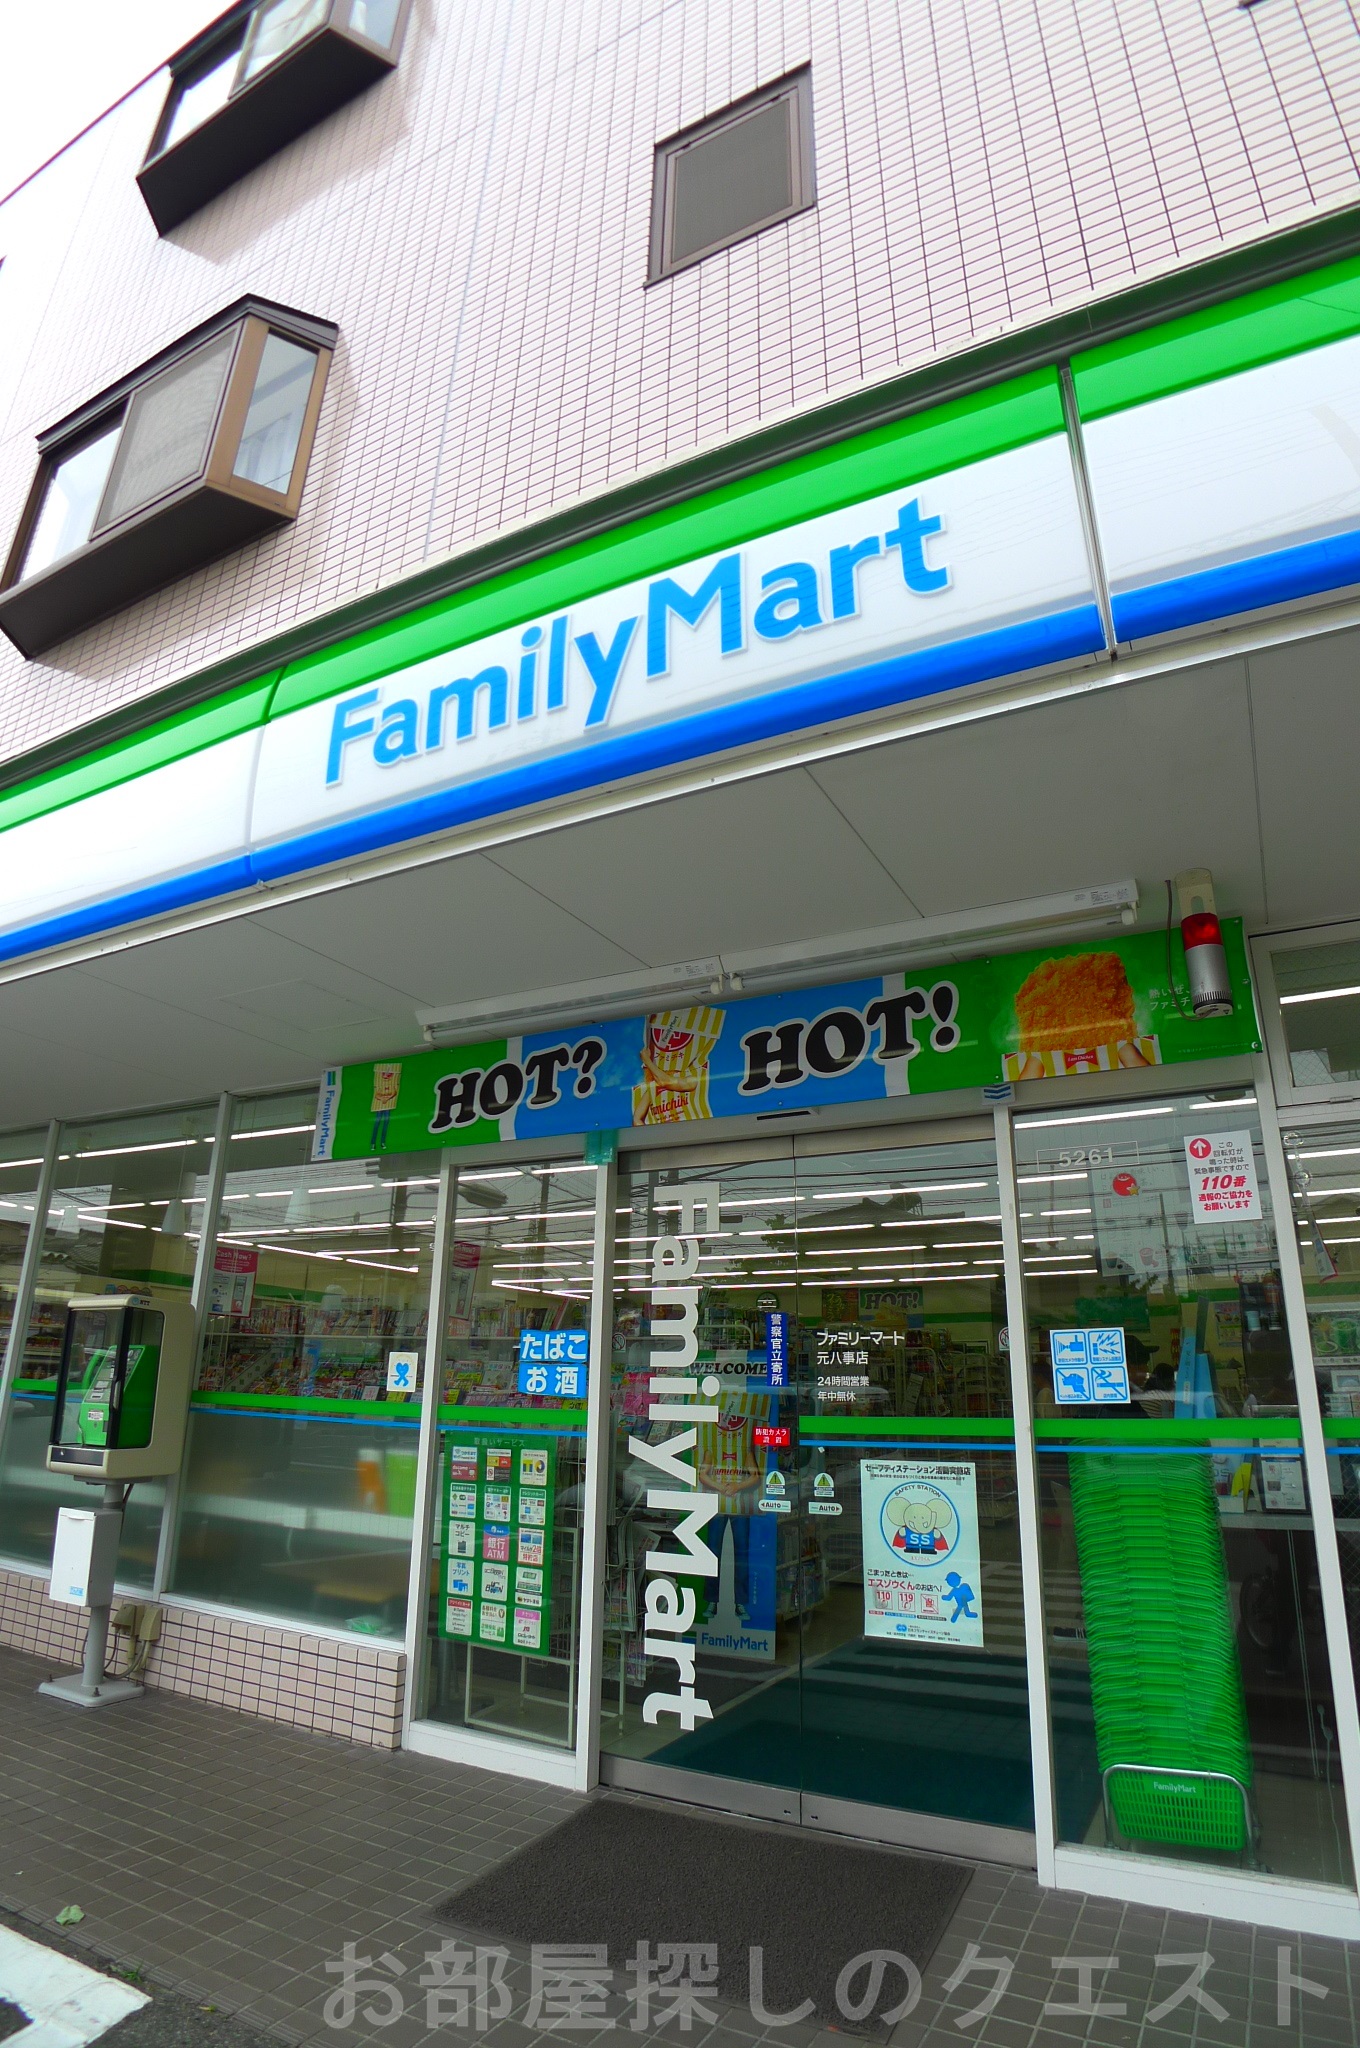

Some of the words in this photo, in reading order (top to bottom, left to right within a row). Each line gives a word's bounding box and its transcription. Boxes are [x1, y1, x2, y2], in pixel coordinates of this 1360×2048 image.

[325, 498, 951, 786] FamilyMart
[740, 984, 957, 1093] HOT!
[430, 1038, 606, 1132] HOT?
[317, 1090, 335, 1156] FamilyMart
[1218, 1141, 1233, 1149] この
[1058, 1147, 1114, 1168] 5261
[1213, 1148, 1243, 1157] 回転灯が
[1201, 1174, 1247, 1191] 110番
[1198, 1189, 1253, 1202] 通報のご協力を
[1203, 1200, 1250, 1211] お願いします
[816, 1330, 905, 1346] ファミリーマート
[520, 1333, 587, 1361] たばこ
[770, 1313, 784, 1386] 警察官立寄所
[816, 1351, 869, 1365] 元八事店
[689, 1361, 767, 1376] WELCOME
[526, 1365, 579, 1395] お酒
[817, 1375, 870, 1387] 24時間営業
[817, 1390, 856, 1402] 年中無休
[755, 1428, 787, 1436] 防犯カメラ
[628, 1182, 721, 1732] FamilyMart
[894, 1484, 915, 1497] SAFETY
[917, 1484, 941, 1498] STATION
[487, 1537, 506, 1550] 銀行
[487, 1549, 505, 1559] ATM
[876, 1591, 891, 1600] 110
[899, 1593, 914, 1602] 119
[701, 1632, 769, 1652] FamilyMart
[1153, 1780, 1197, 1794] FamilyMart
